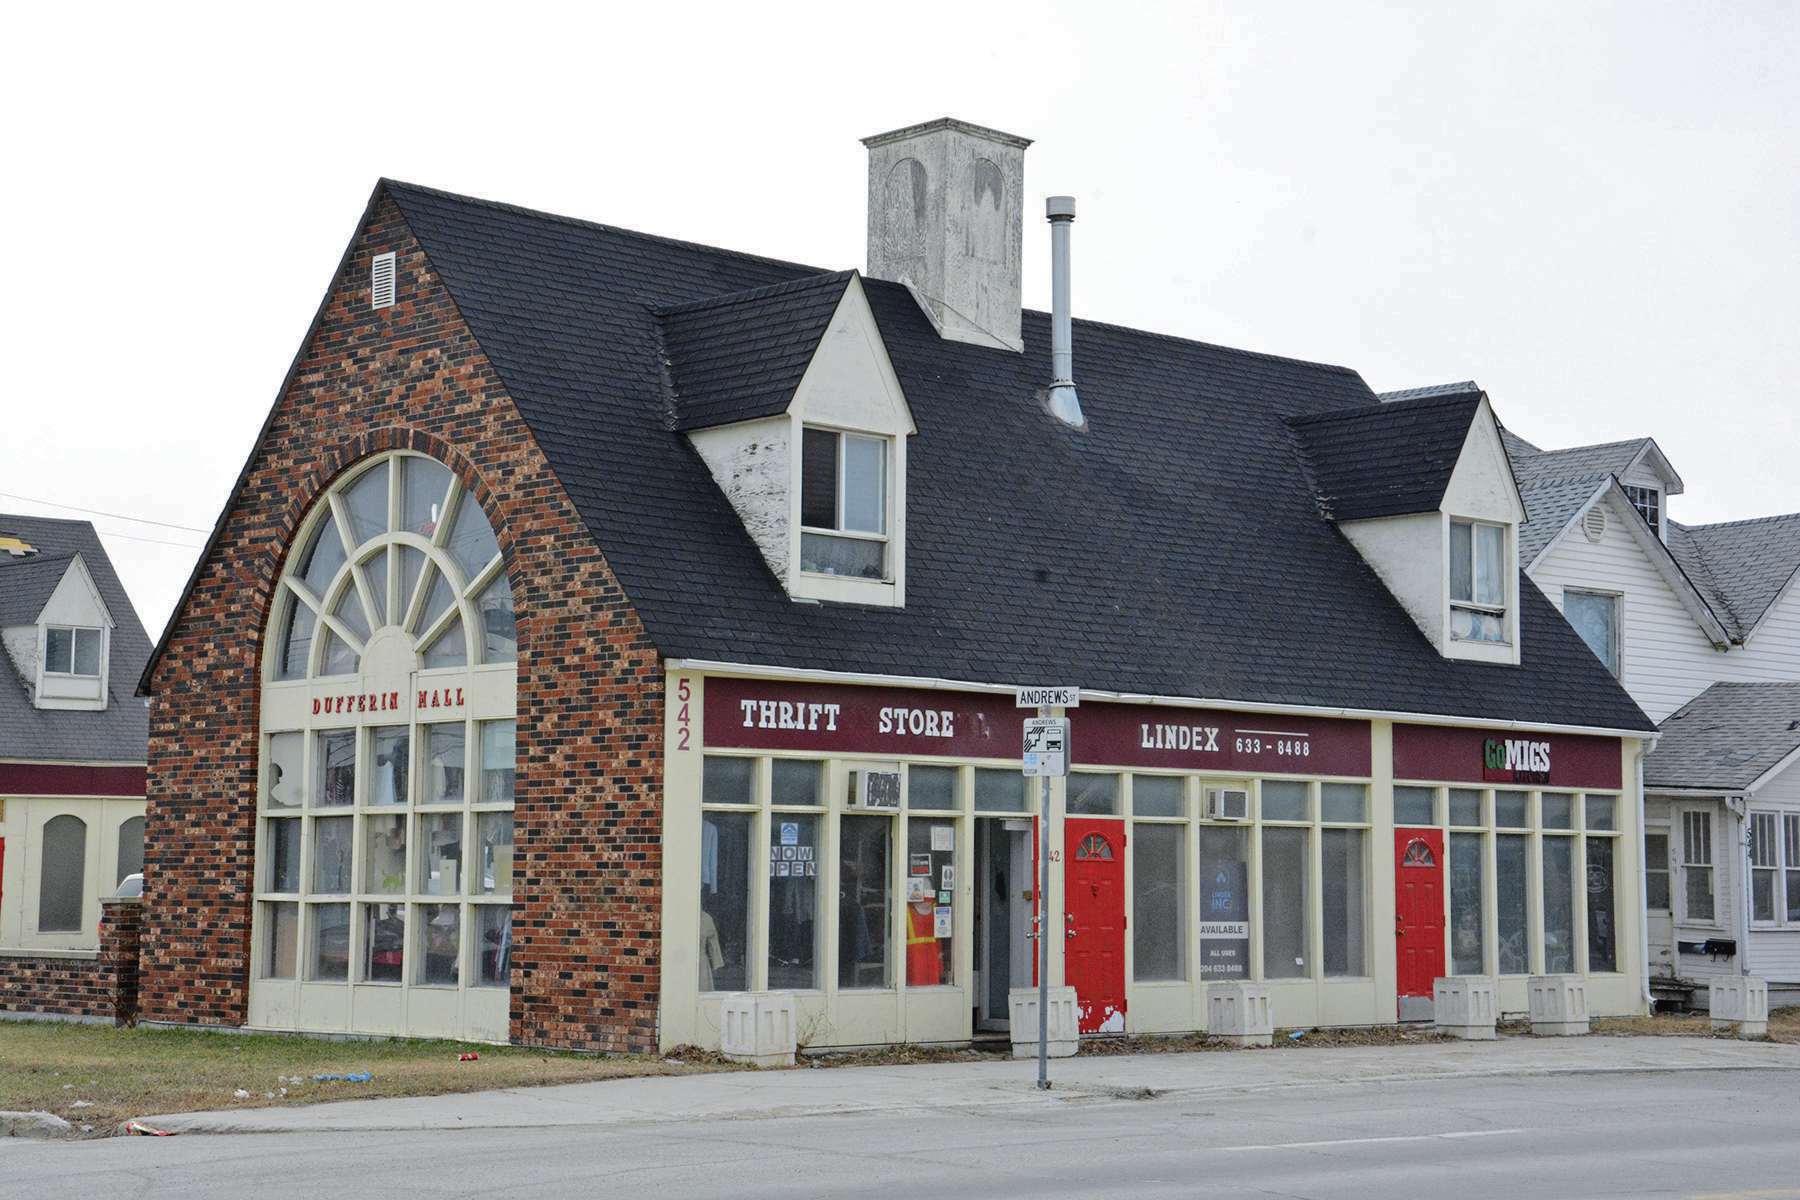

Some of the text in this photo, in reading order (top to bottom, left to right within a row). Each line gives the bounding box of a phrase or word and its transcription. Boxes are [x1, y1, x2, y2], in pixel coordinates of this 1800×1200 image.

[312, 692, 399, 715] DUFFERIN
[1020, 690, 1069, 705] ANDREWS
[740, 699, 954, 738] THRIFT STORE
[1141, 723, 1219, 752] LINDEX
[1484, 738, 1551, 773] GoMIGS
[770, 847, 813, 860] NOW
[1200, 925, 1244, 934] AVAILABLE
